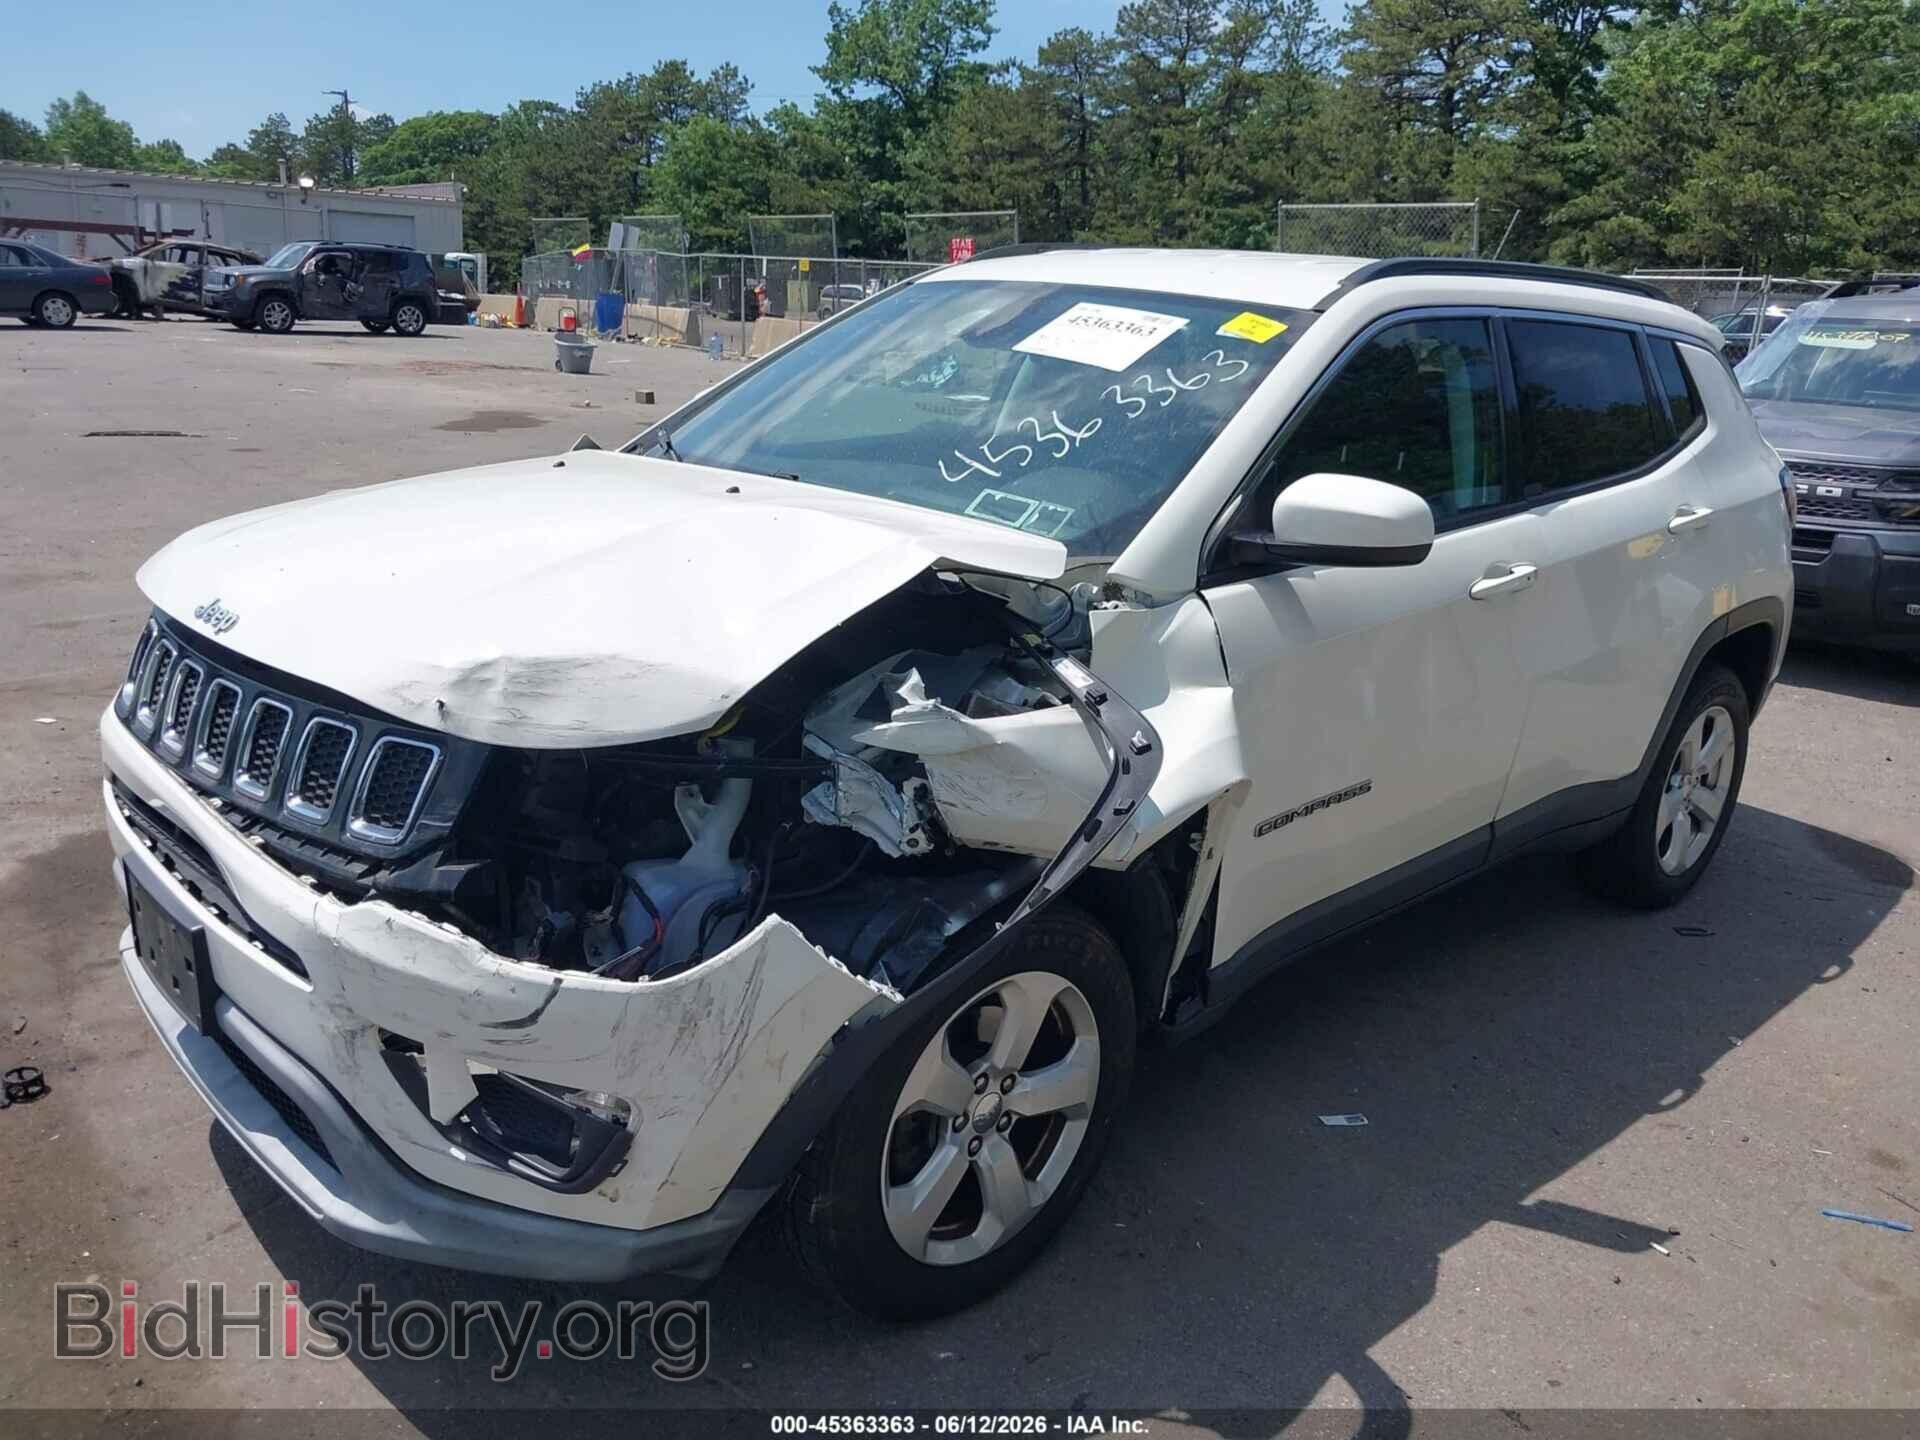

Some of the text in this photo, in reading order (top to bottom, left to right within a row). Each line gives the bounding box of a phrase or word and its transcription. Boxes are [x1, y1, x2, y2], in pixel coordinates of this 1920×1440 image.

[951, 238, 973, 249] STATE
[1068, 315, 1157, 337] 45363363
[1099, 350, 1249, 418] 3363
[194, 598, 240, 636] Jeep
[1254, 779, 1373, 838] COMPASS
